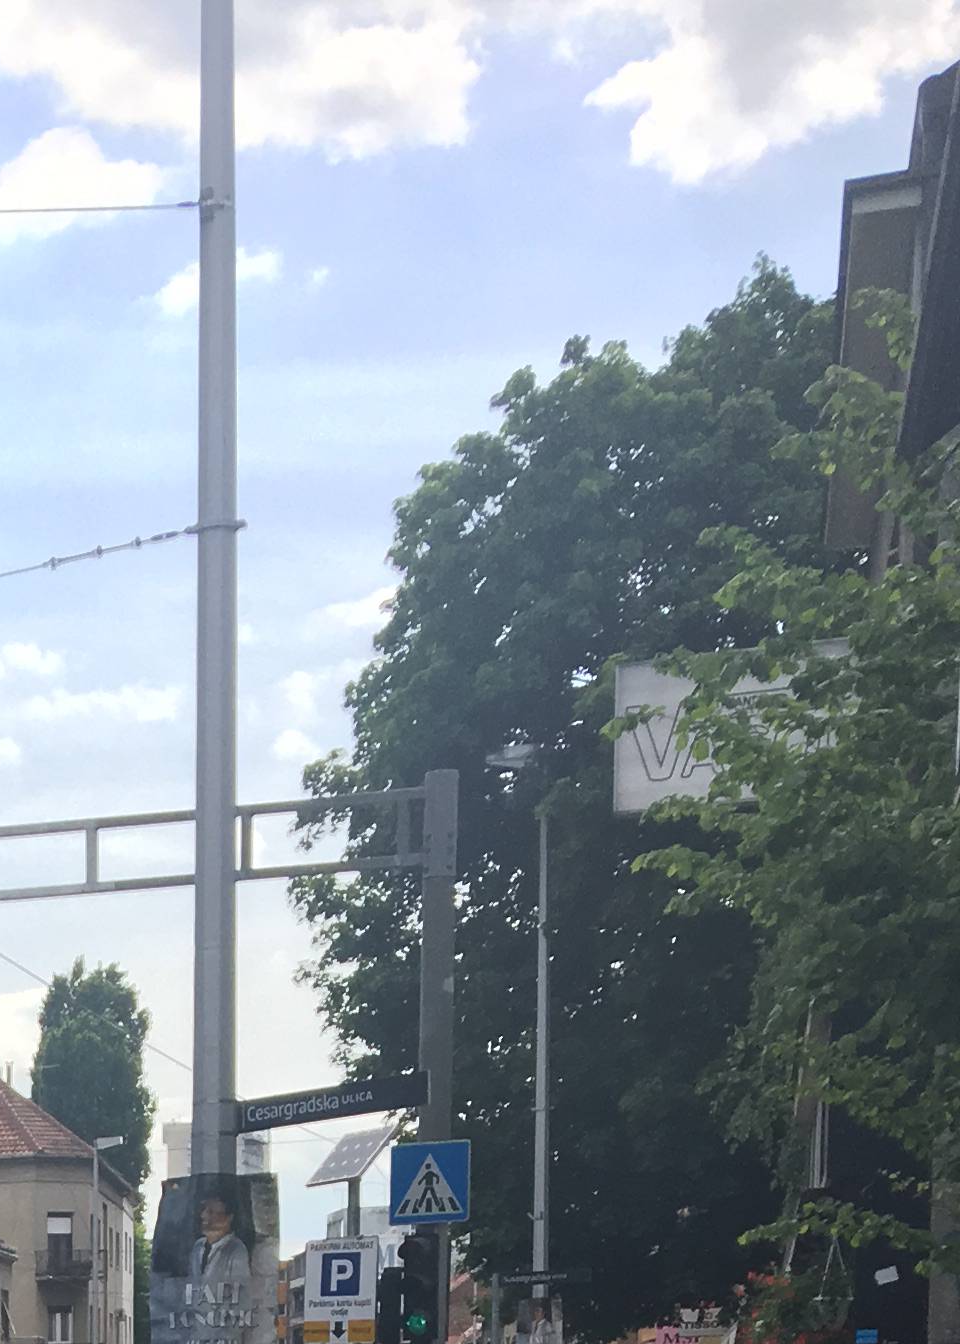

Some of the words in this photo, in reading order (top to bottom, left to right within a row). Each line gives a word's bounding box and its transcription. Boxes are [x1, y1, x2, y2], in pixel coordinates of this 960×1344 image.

[247, 1093, 340, 1122] Cesargradska
[341, 1090, 373, 1105] ULICA
[330, 1259, 354, 1292] P
